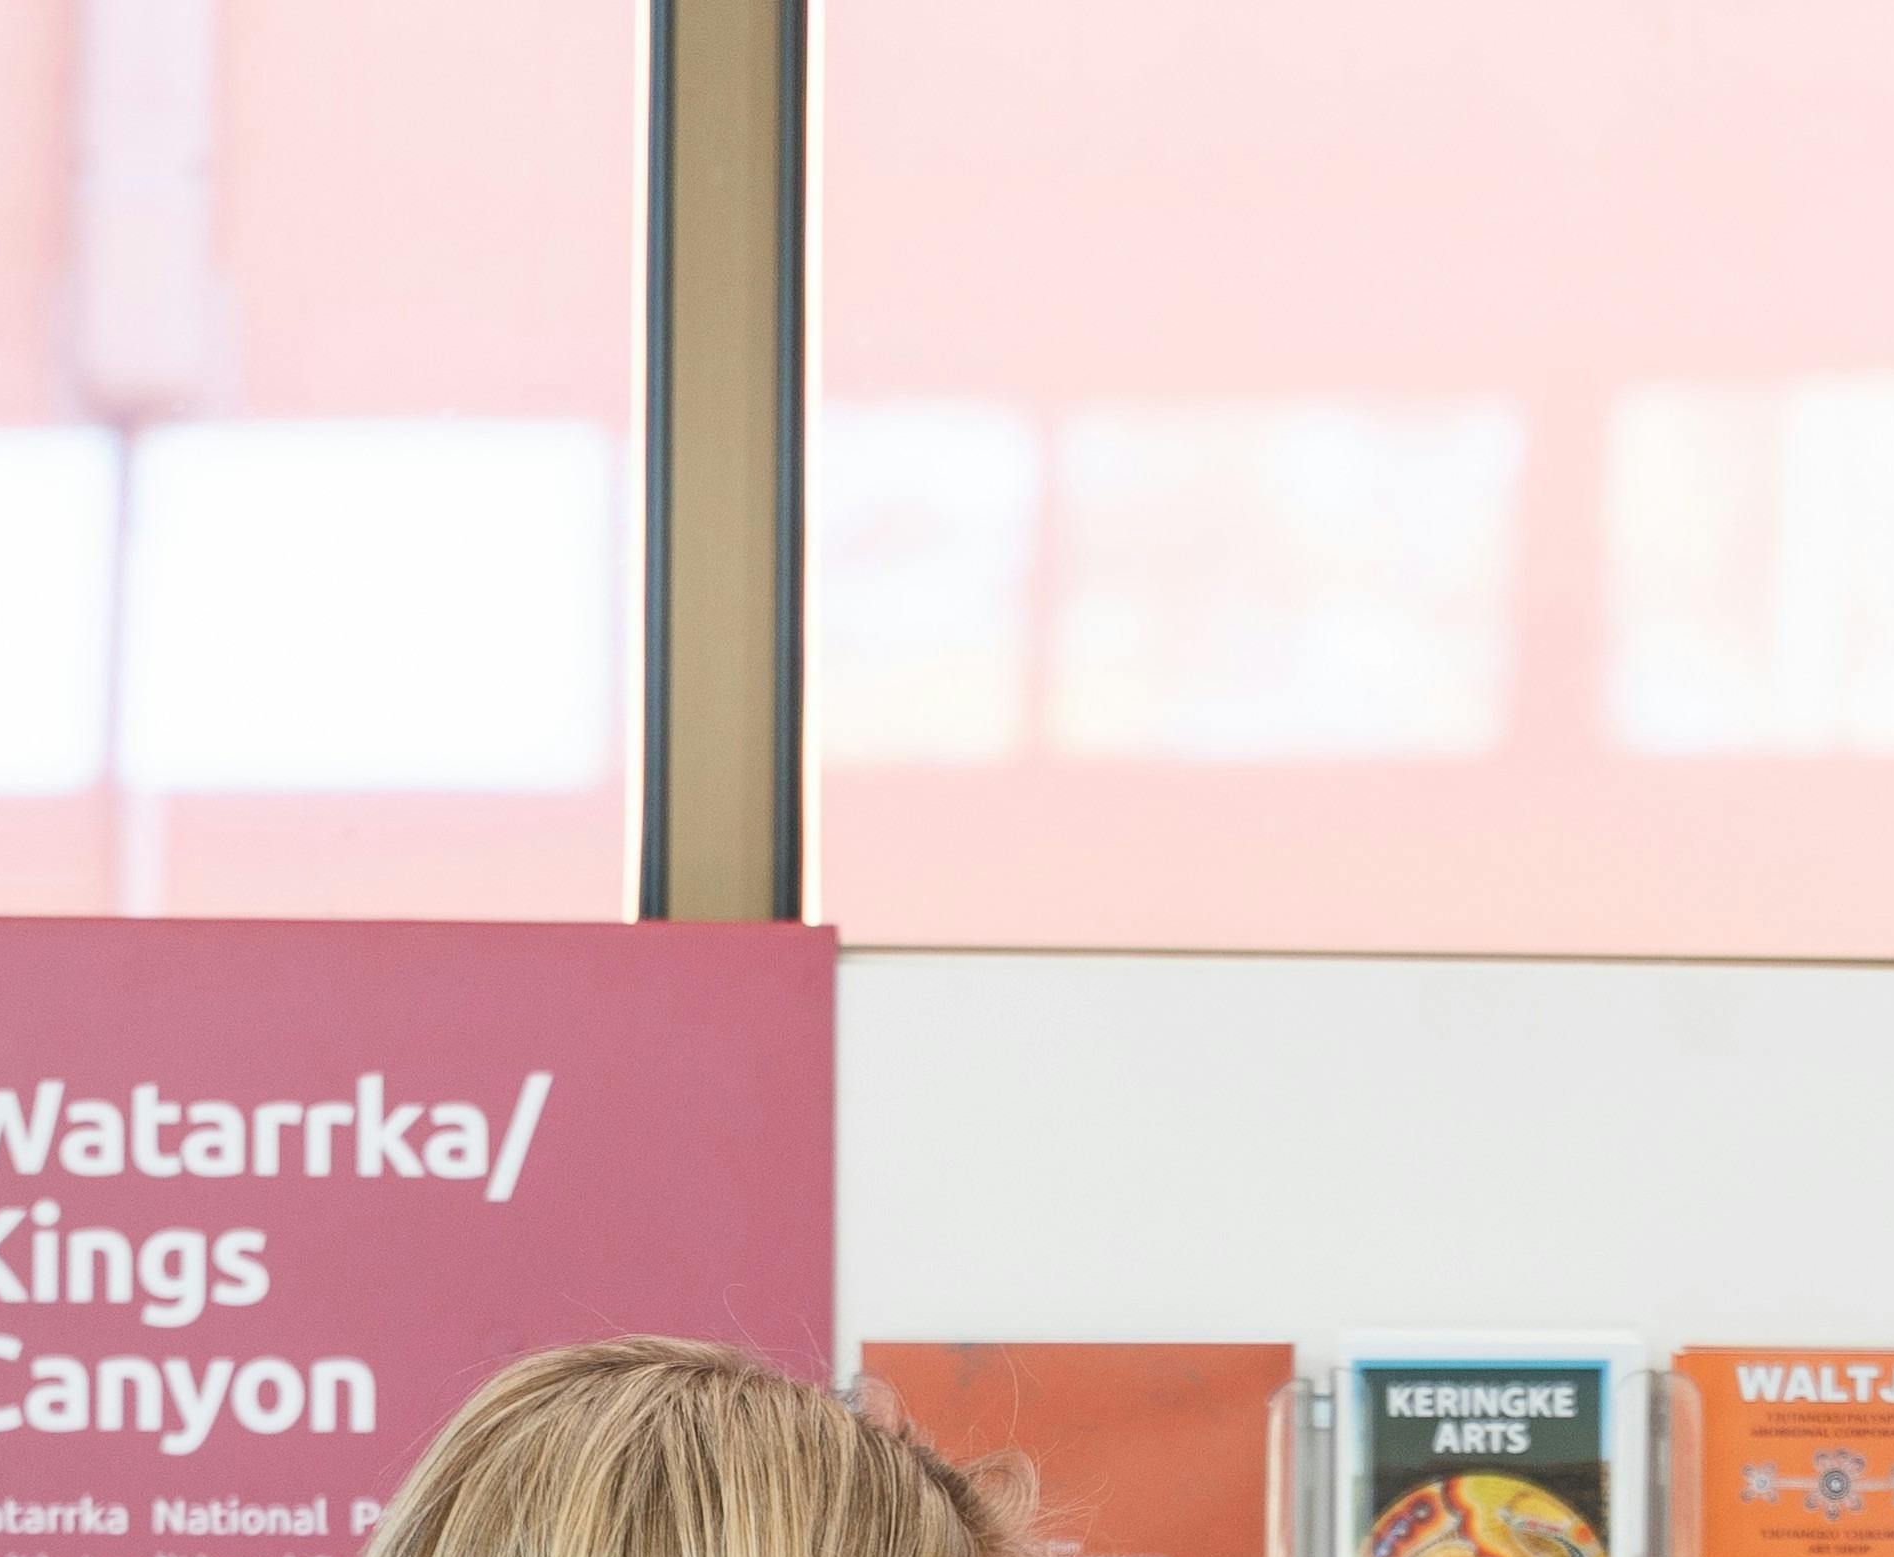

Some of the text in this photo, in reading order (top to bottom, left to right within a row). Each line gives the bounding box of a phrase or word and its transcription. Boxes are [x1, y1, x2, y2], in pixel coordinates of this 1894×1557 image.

[1388, 1384, 1576, 1419] KERINGKE
[1434, 1420, 1529, 1454] ARTS
[152, 1498, 328, 1536] National
